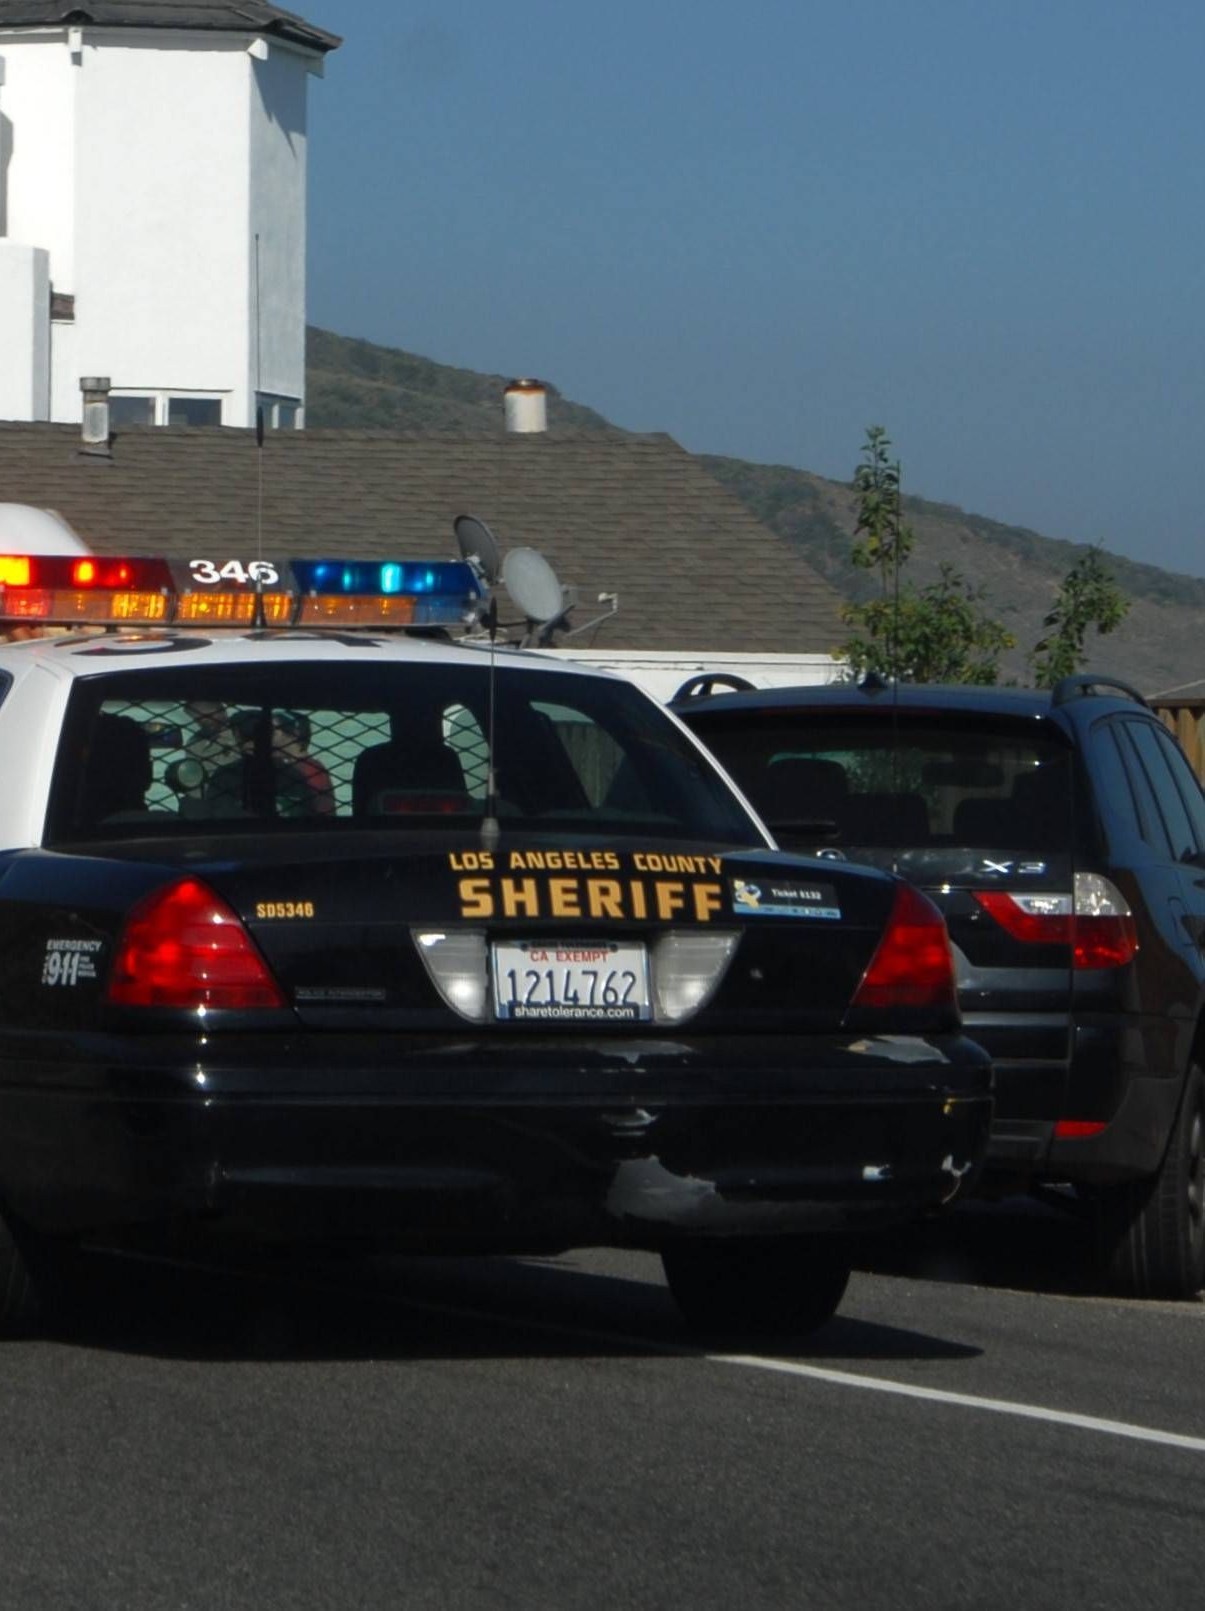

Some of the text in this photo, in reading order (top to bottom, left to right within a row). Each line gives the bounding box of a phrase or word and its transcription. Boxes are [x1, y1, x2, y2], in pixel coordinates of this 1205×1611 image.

[189, 559, 279, 584] 346
[449, 852, 722, 875] LOS ANGELES COUNTY
[458, 877, 722, 922] SHERIFF
[46, 939, 102, 952] EMERGENCY
[530, 949, 609, 963] CA EXEMPT
[507, 968, 636, 1005] 1214762
[514, 1005, 634, 1018] sharetolerance.com
